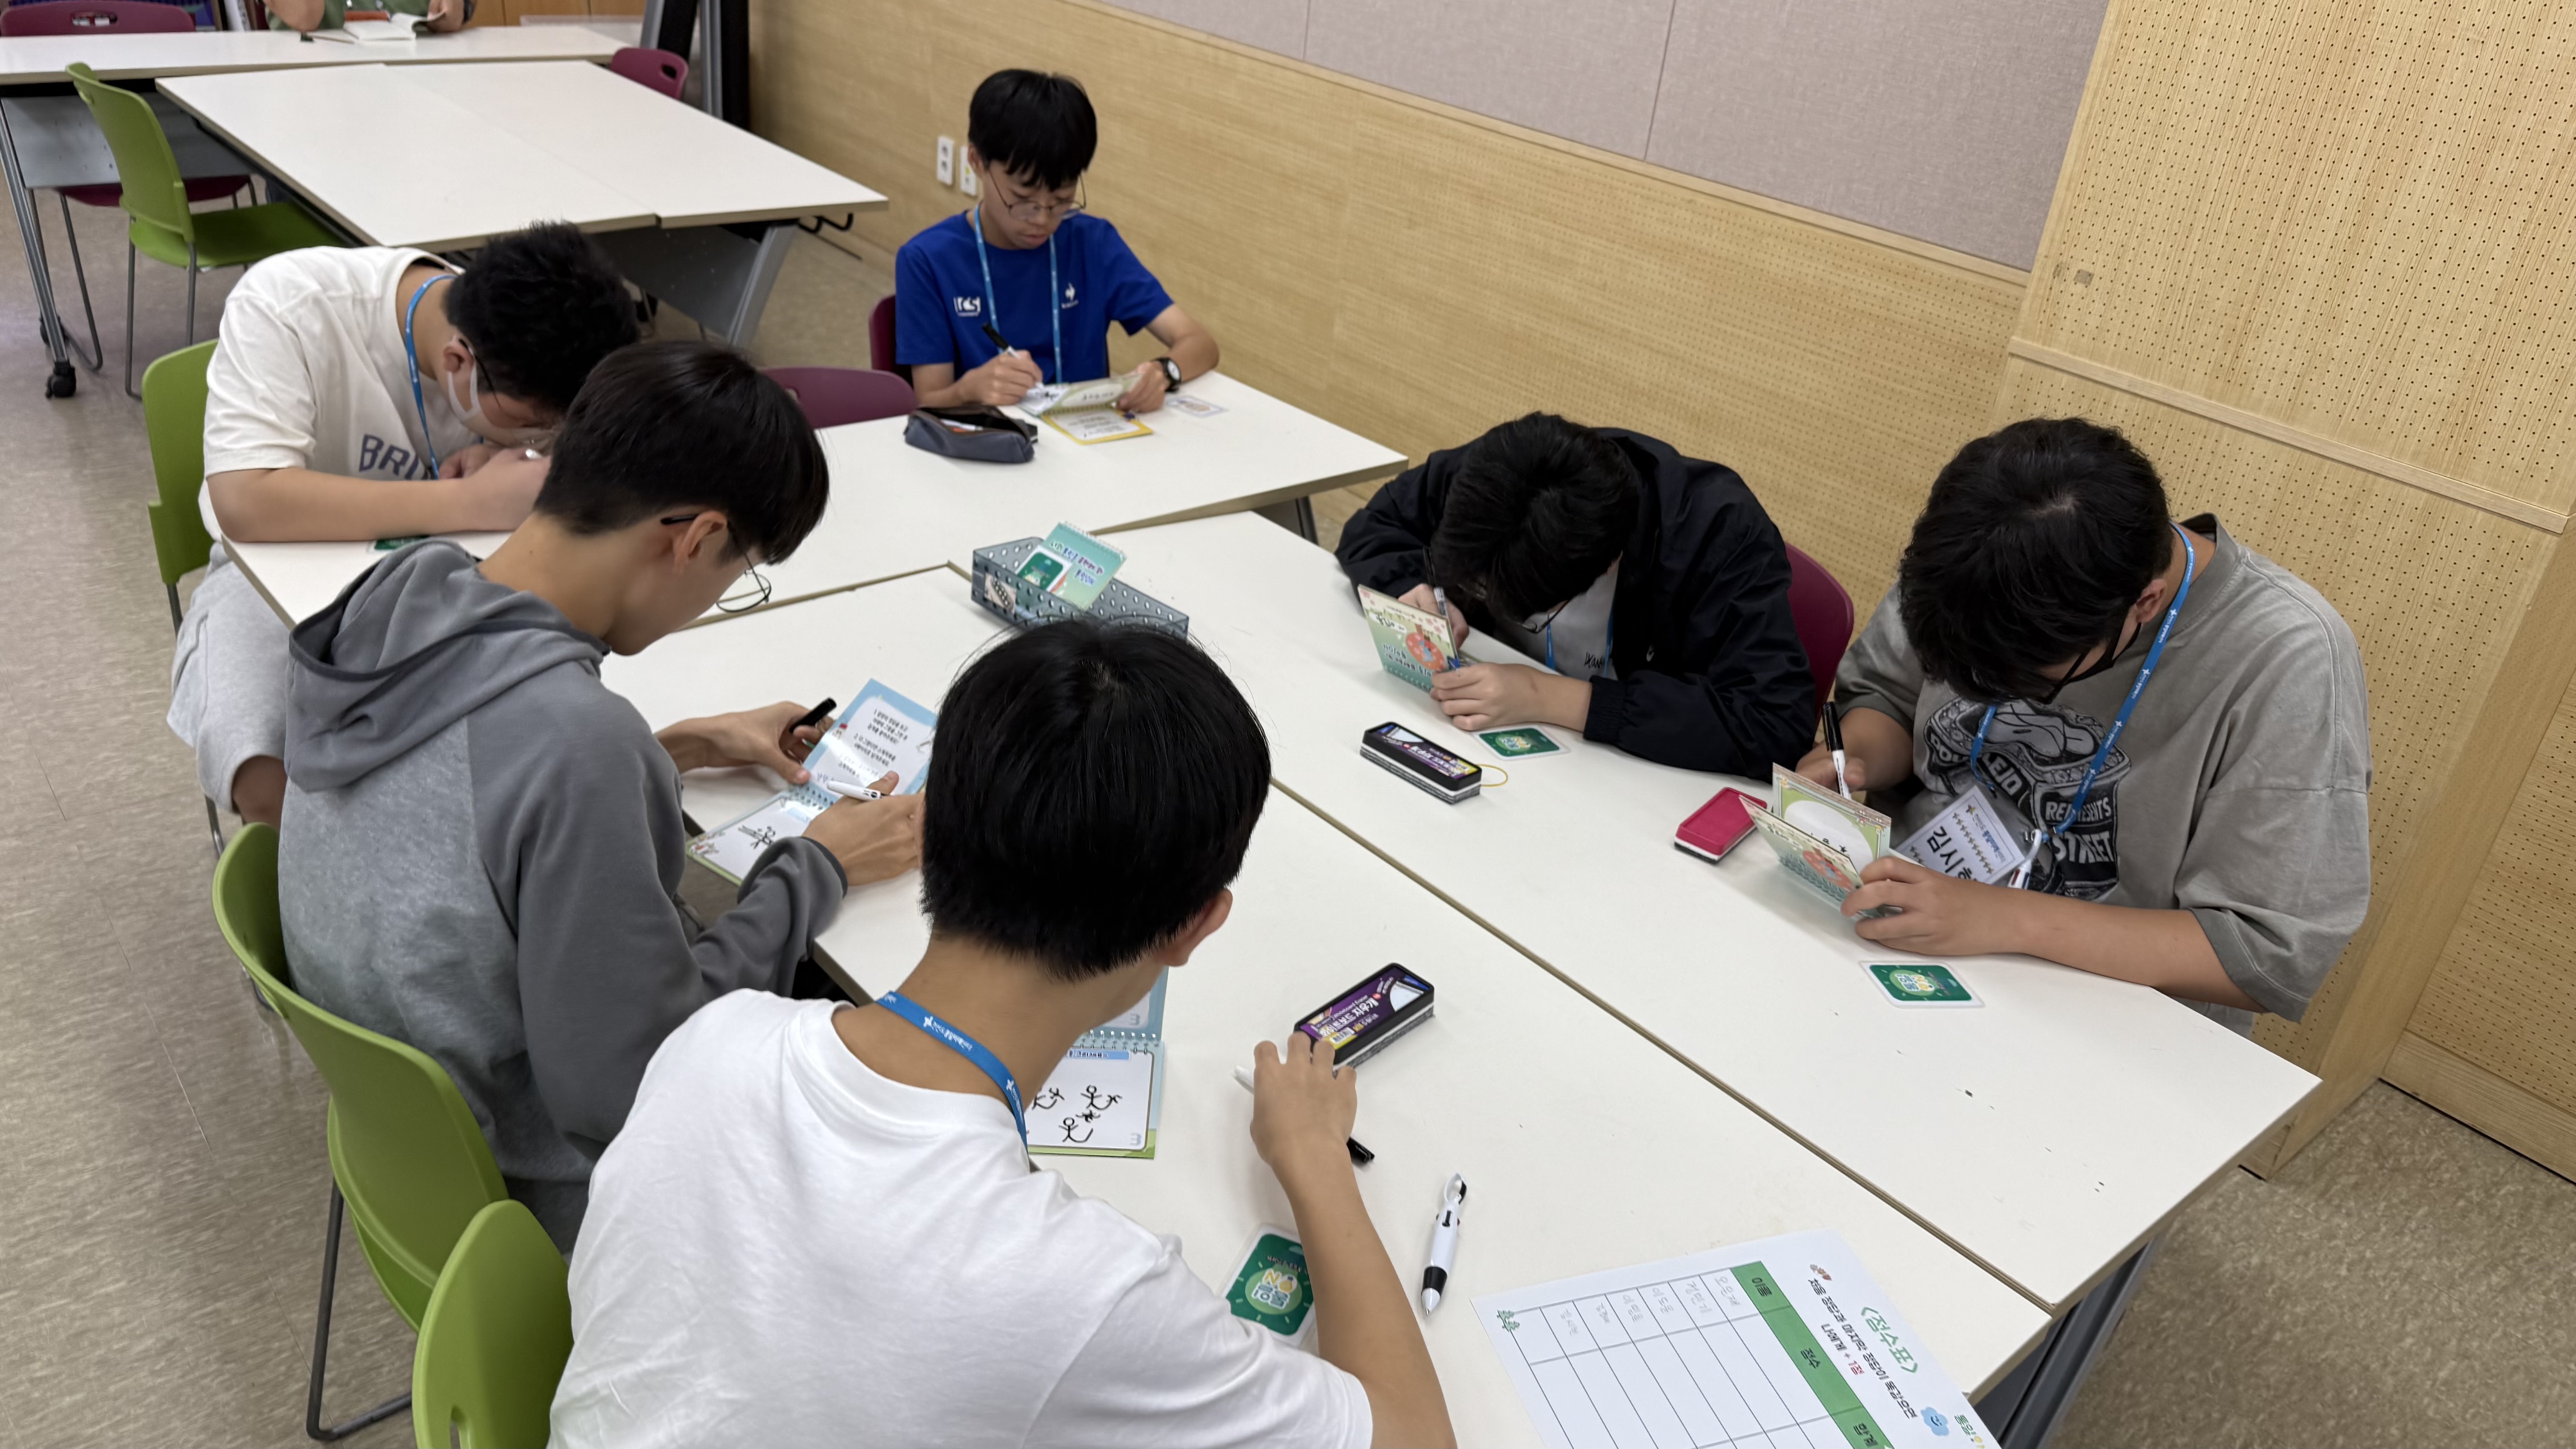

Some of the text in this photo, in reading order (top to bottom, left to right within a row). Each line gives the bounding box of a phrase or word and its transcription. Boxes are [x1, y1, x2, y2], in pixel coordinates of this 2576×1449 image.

[2052, 831, 2114, 864] STREET
[1129, 1133, 1141, 1146] 3
[1752, 1277, 1878, 1448] 이름 점수 합계
[1821, 1324, 1847, 1352] 나에게
[1849, 1360, 1865, 1375] 1점
[1822, 1296, 1847, 1323] 정답과
[1842, 1324, 1868, 1351] 마지막
[1863, 1352, 1890, 1380] 정답이
[1885, 1381, 1918, 1419] 똑같으면
